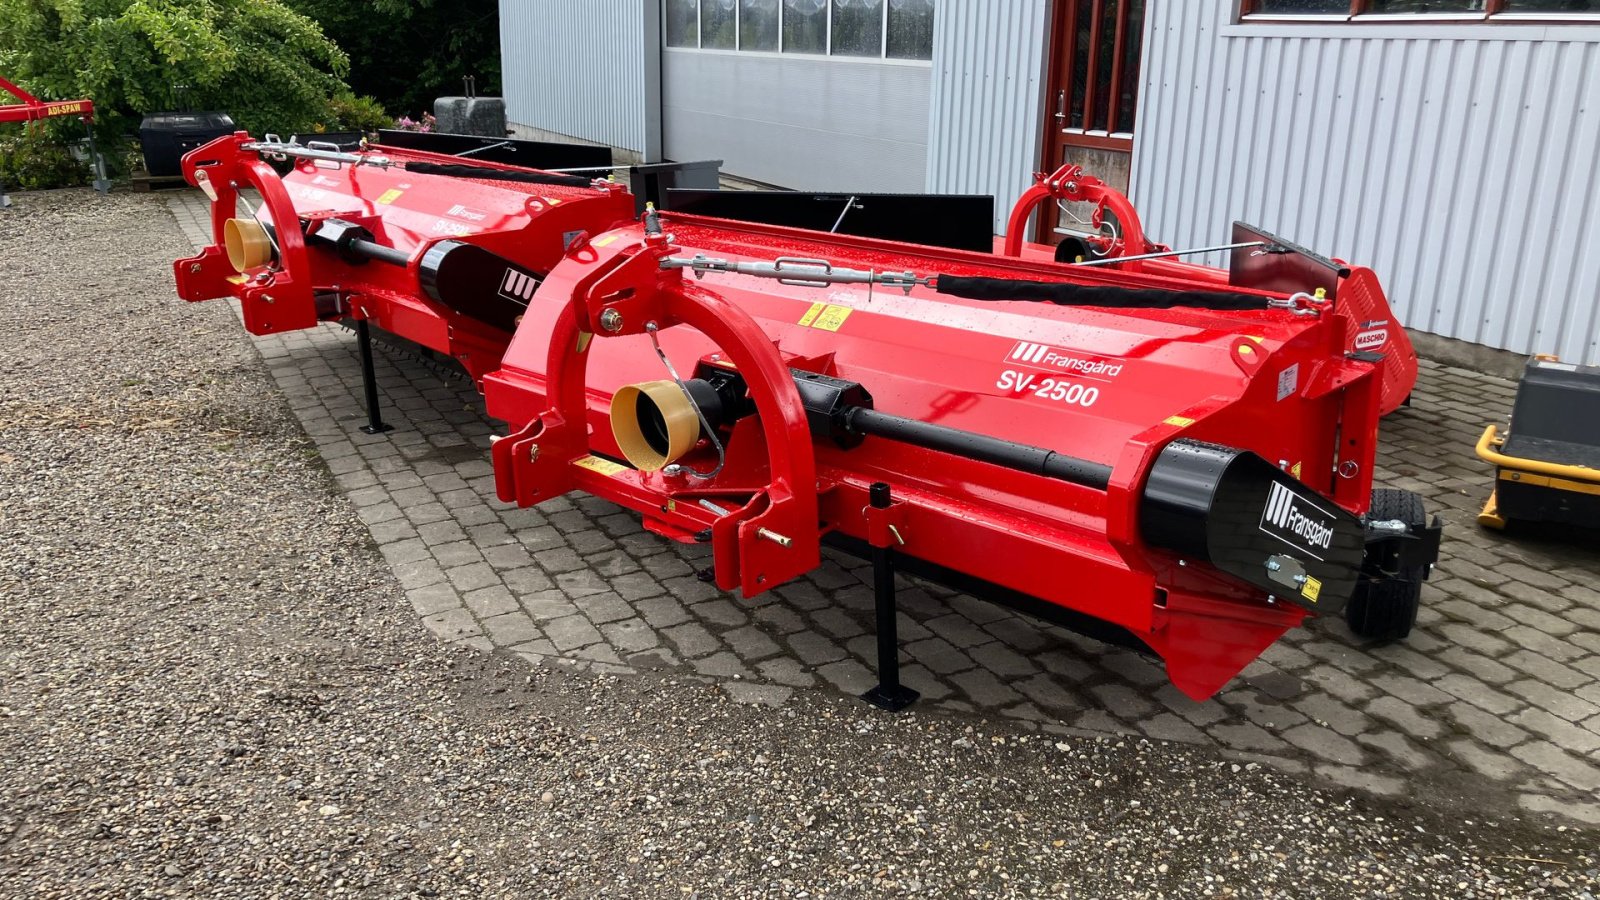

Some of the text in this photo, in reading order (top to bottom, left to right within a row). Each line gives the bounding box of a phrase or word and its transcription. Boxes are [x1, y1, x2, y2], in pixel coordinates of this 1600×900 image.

[48, 103, 80, 116] ADI-SPAW
[1357, 332, 1385, 345] MASCHIO
[1043, 352, 1123, 377] Fransgård
[996, 370, 1099, 407] SV-2500
[1286, 505, 1334, 549] Fransgård
